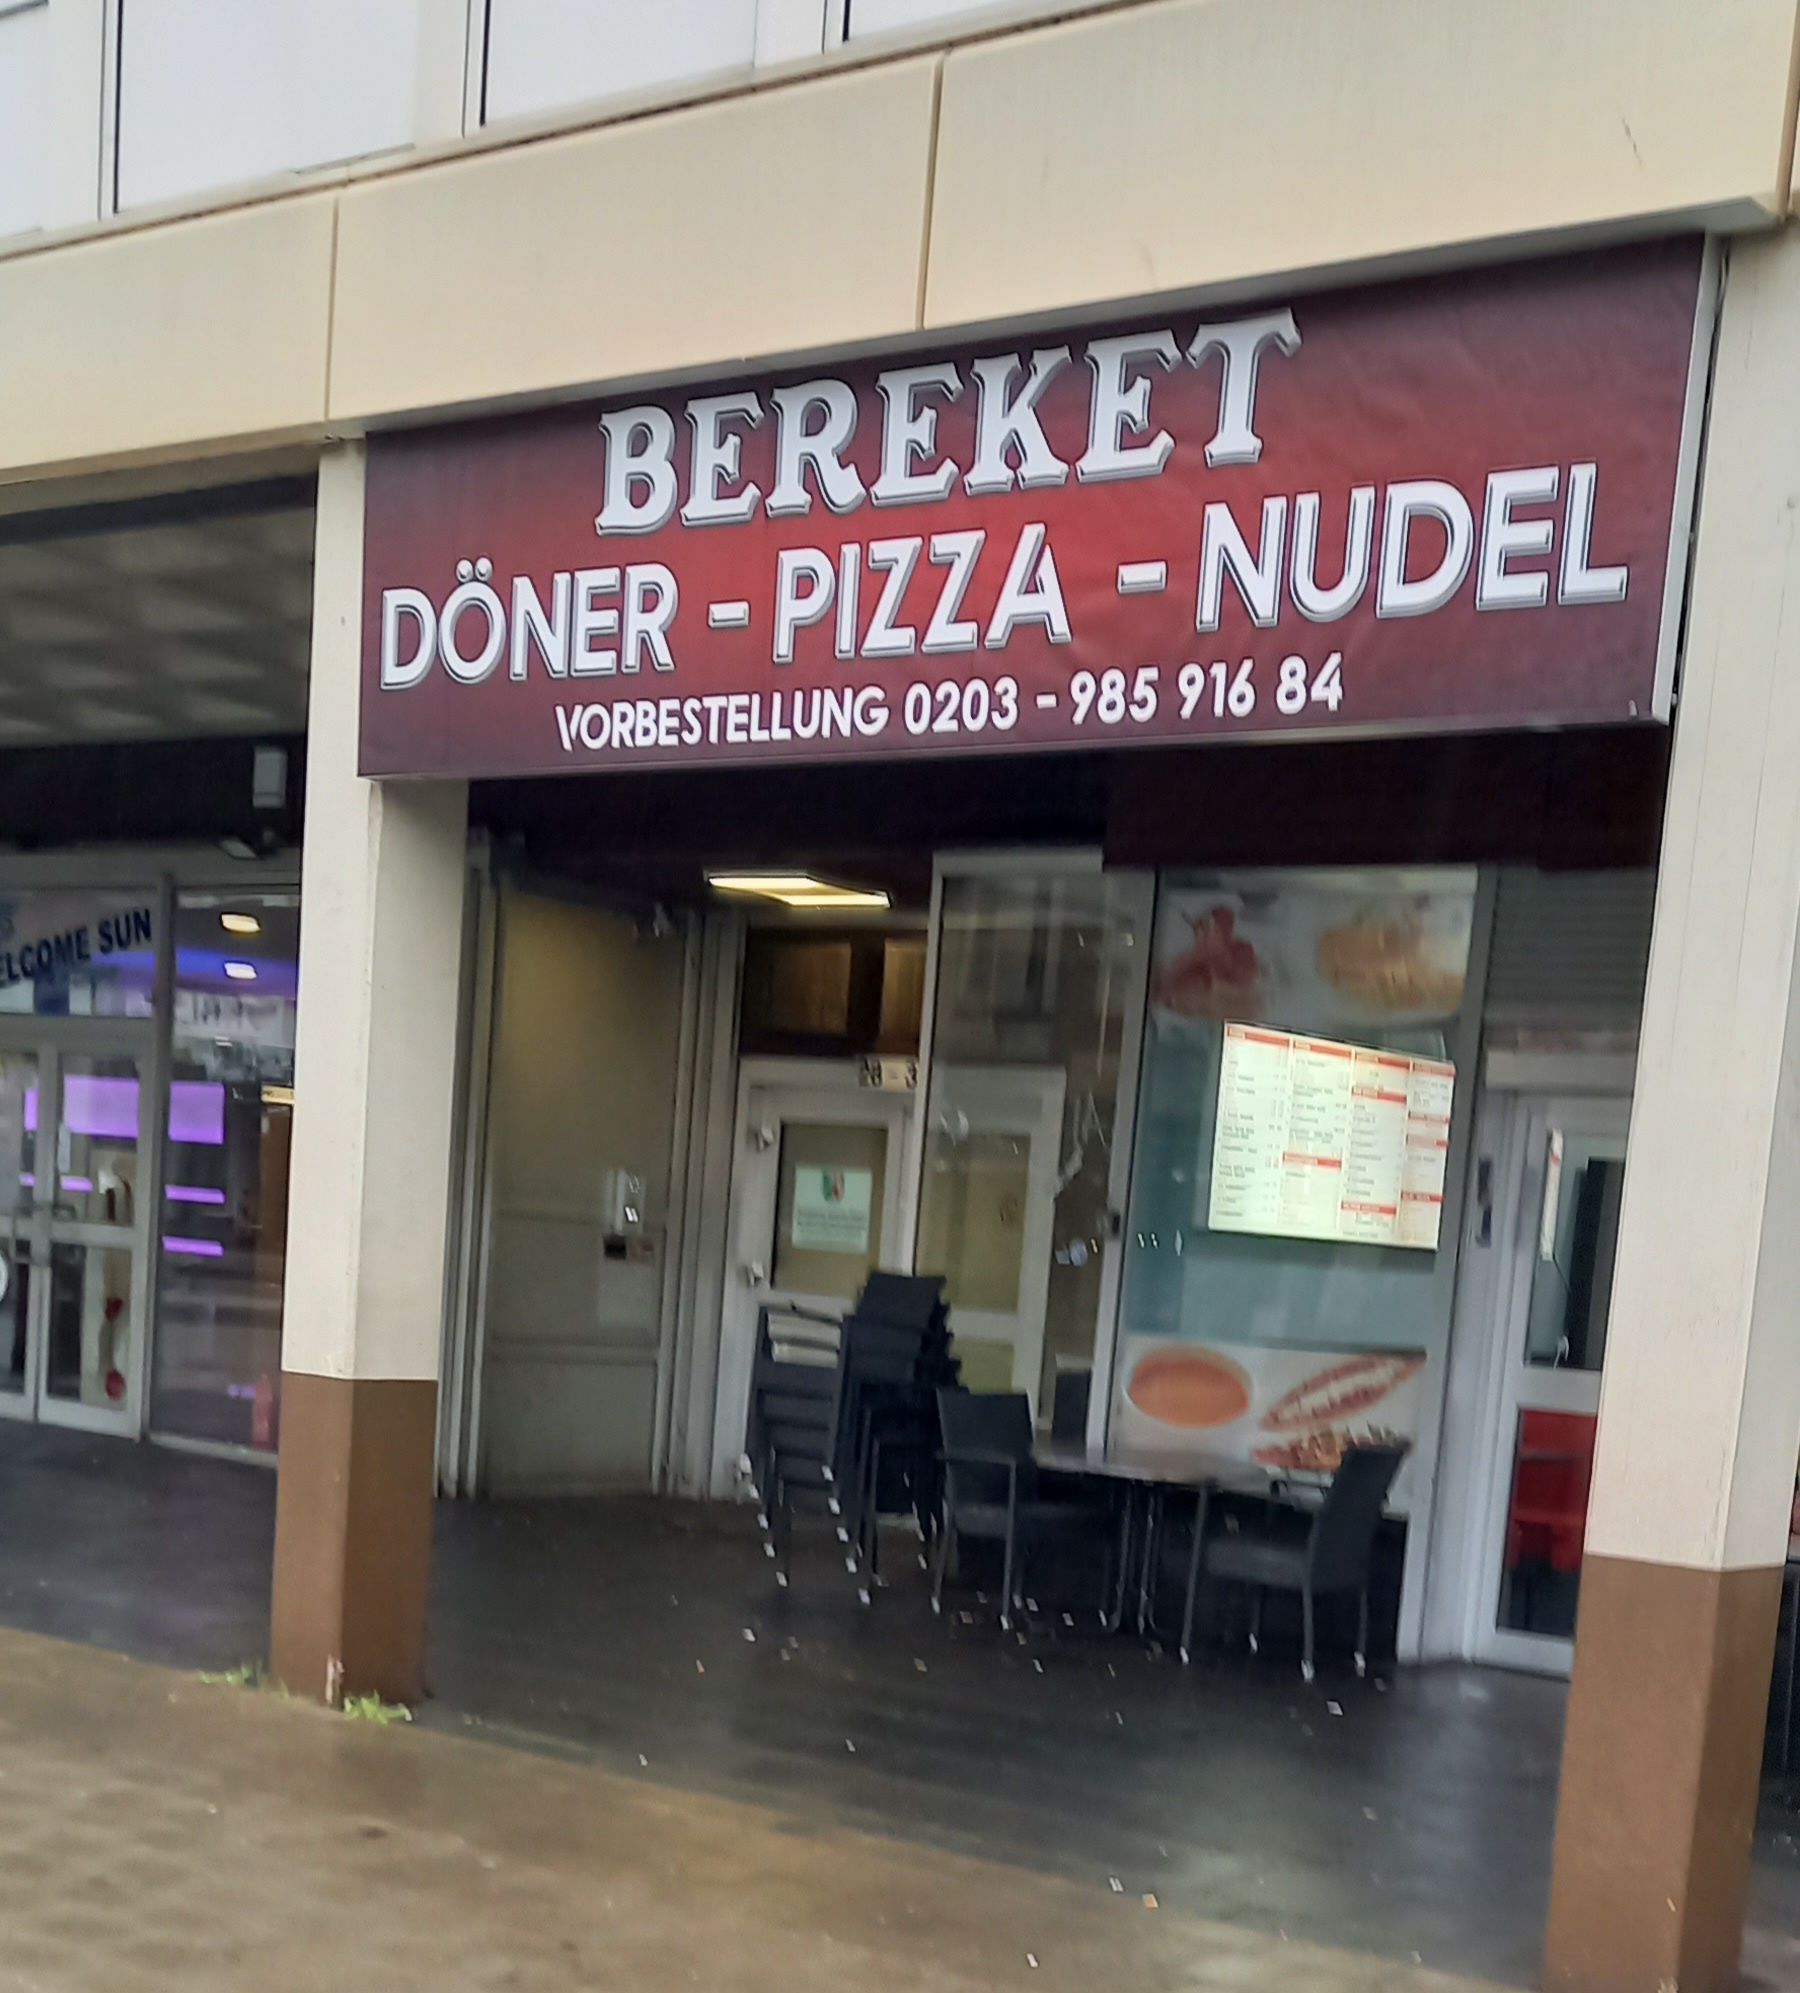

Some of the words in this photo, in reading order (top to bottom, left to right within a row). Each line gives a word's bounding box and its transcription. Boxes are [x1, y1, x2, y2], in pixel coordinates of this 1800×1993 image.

[595, 308, 1301, 536] BEREKET
[380, 556, 680, 691] DÖNER
[708, 600, 751, 629] -
[772, 521, 1072, 664] PIZZA
[1117, 560, 1167, 594] -
[1196, 461, 1629, 633] NUDEL
[555, 686, 889, 751] VORBESTELLUNG
[903, 674, 1019, 737] 0203
[1036, 694, 1058, 710] -
[1070, 666, 1160, 725] 985
[1178, 657, 1257, 720] 916
[1274, 651, 1343, 713] 84
[98, 907, 152, 955] SUN
